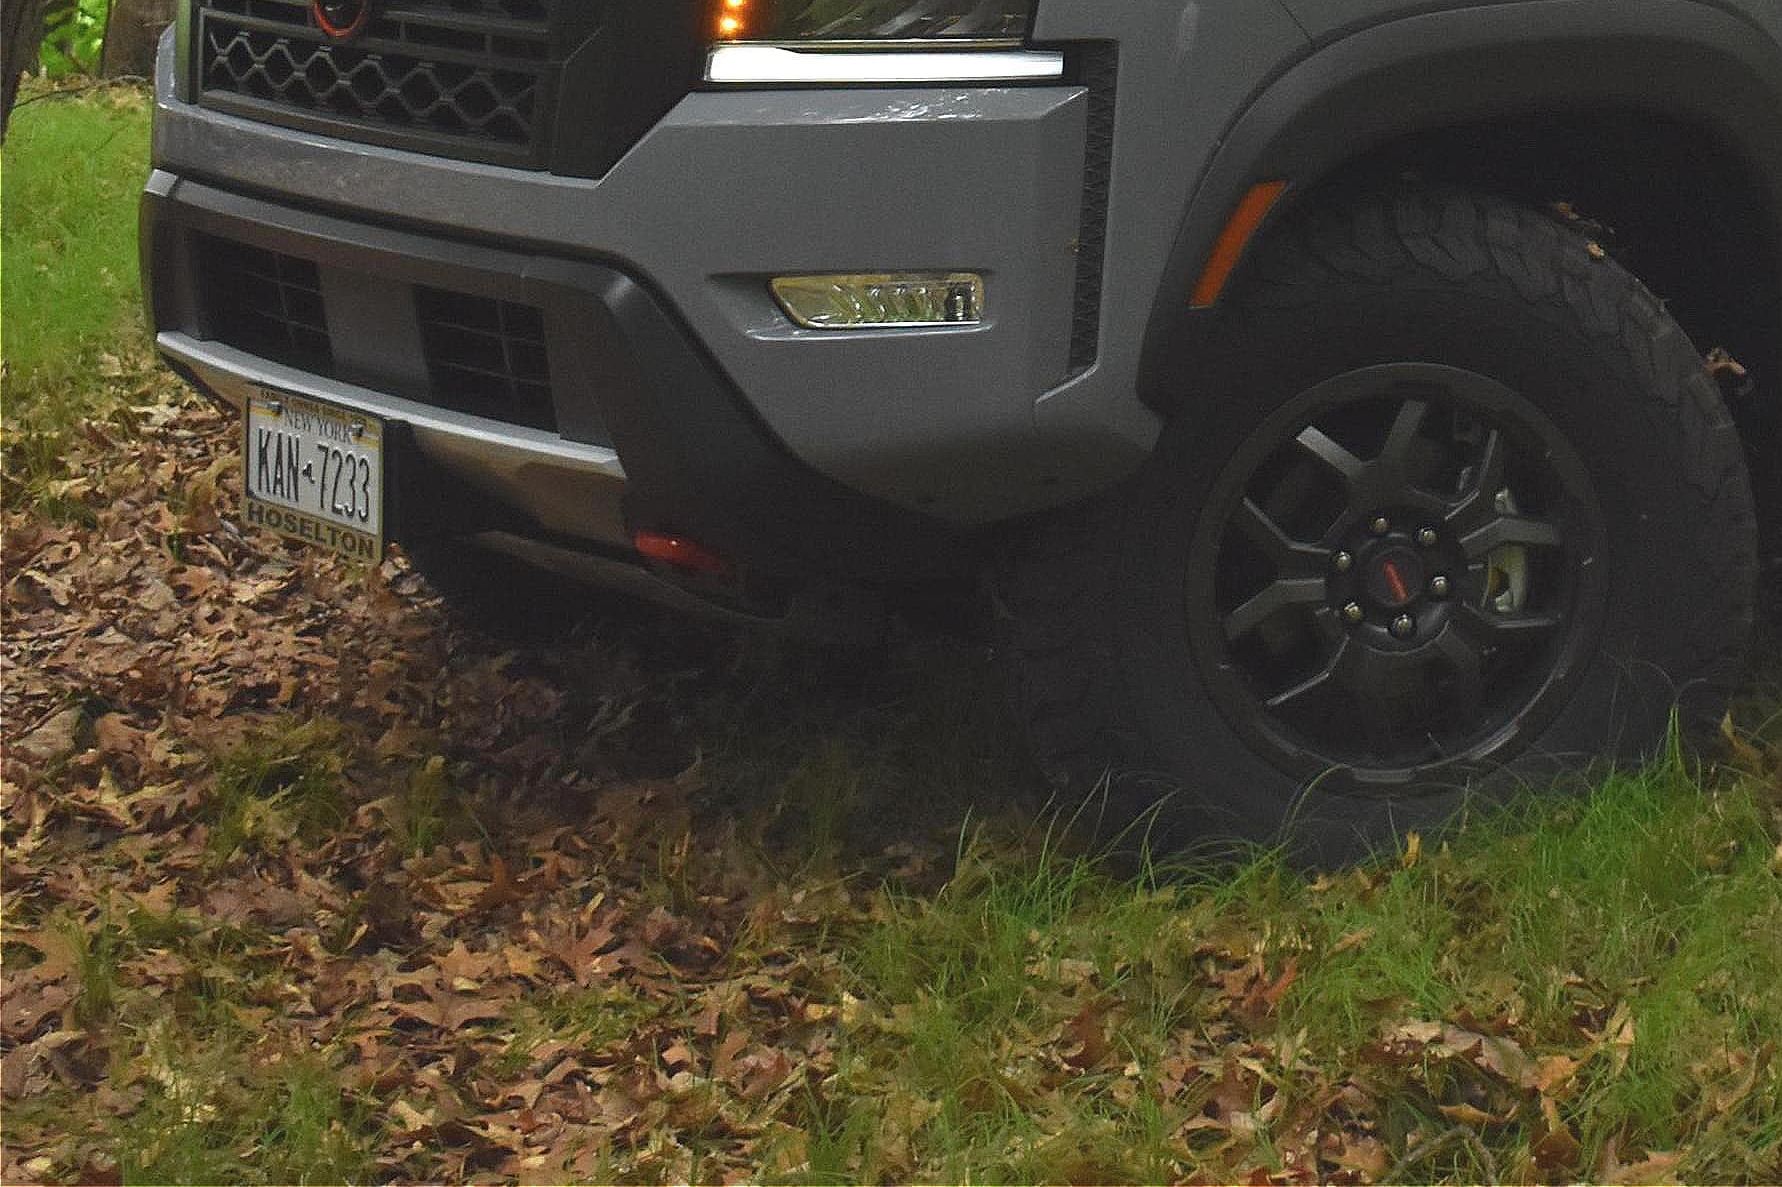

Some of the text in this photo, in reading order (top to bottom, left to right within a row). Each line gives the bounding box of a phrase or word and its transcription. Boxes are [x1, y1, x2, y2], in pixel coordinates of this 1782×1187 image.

[283, 407, 316, 433] NEW
[316, 415, 353, 445] YORK
[246, 501, 374, 559] HOSELTON
